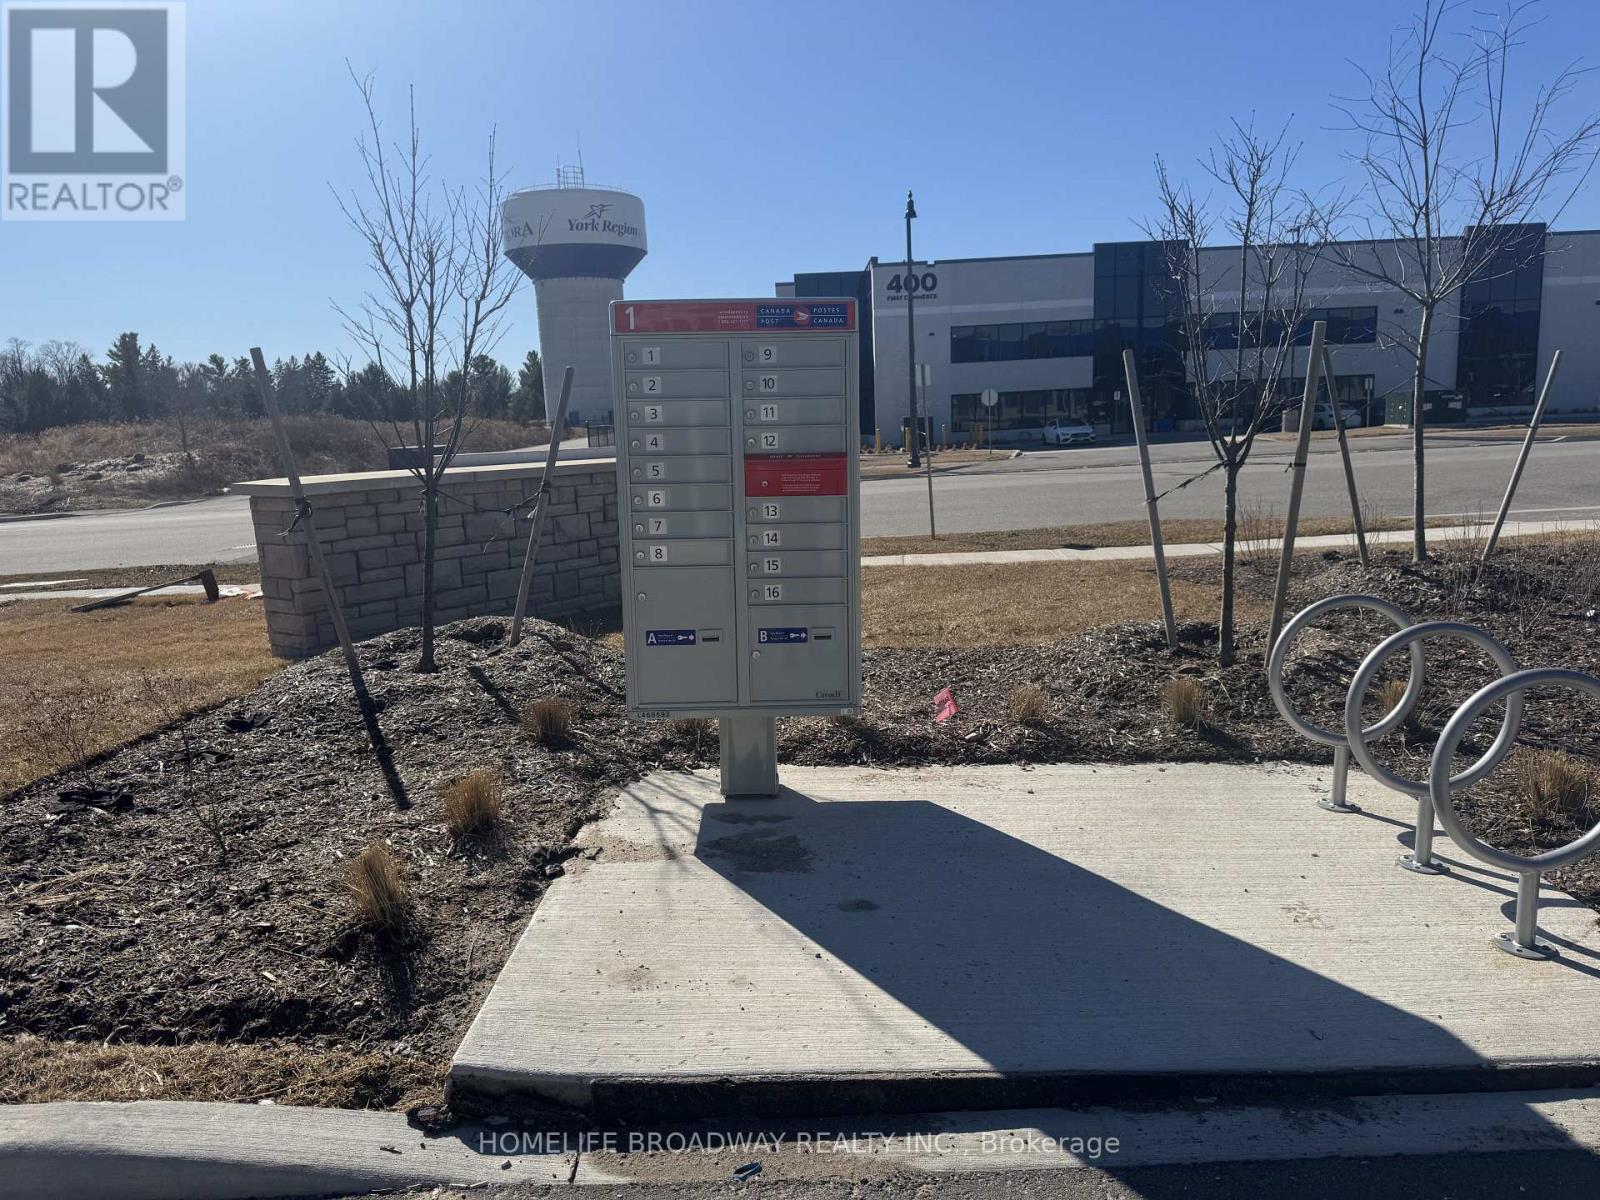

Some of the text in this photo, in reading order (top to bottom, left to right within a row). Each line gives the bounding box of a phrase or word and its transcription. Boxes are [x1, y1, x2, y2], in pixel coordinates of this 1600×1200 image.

[505, 220, 534, 241] ORA
[568, 218, 639, 237] York Region
[886, 272, 938, 294] 400
[624, 306, 635, 330] 1
[647, 350, 654, 362] 1
[763, 348, 772, 361] 9
[648, 379, 657, 391] 2
[762, 377, 775, 390] 10
[650, 408, 658, 420] 3
[763, 406, 774, 418] 11
[650, 436, 659, 449] 4
[763, 435, 776, 447] 12
[652, 464, 660, 477] 5
[652, 492, 661, 505] 6
[764, 505, 778, 517] 13
[654, 520, 662, 532] 7
[765, 532, 778, 544] 14
[654, 548, 663, 560] 8
[766, 559, 779, 571] 15
[766, 586, 780, 599] 16
[647, 632, 657, 644] A
[760, 631, 768, 642] B
